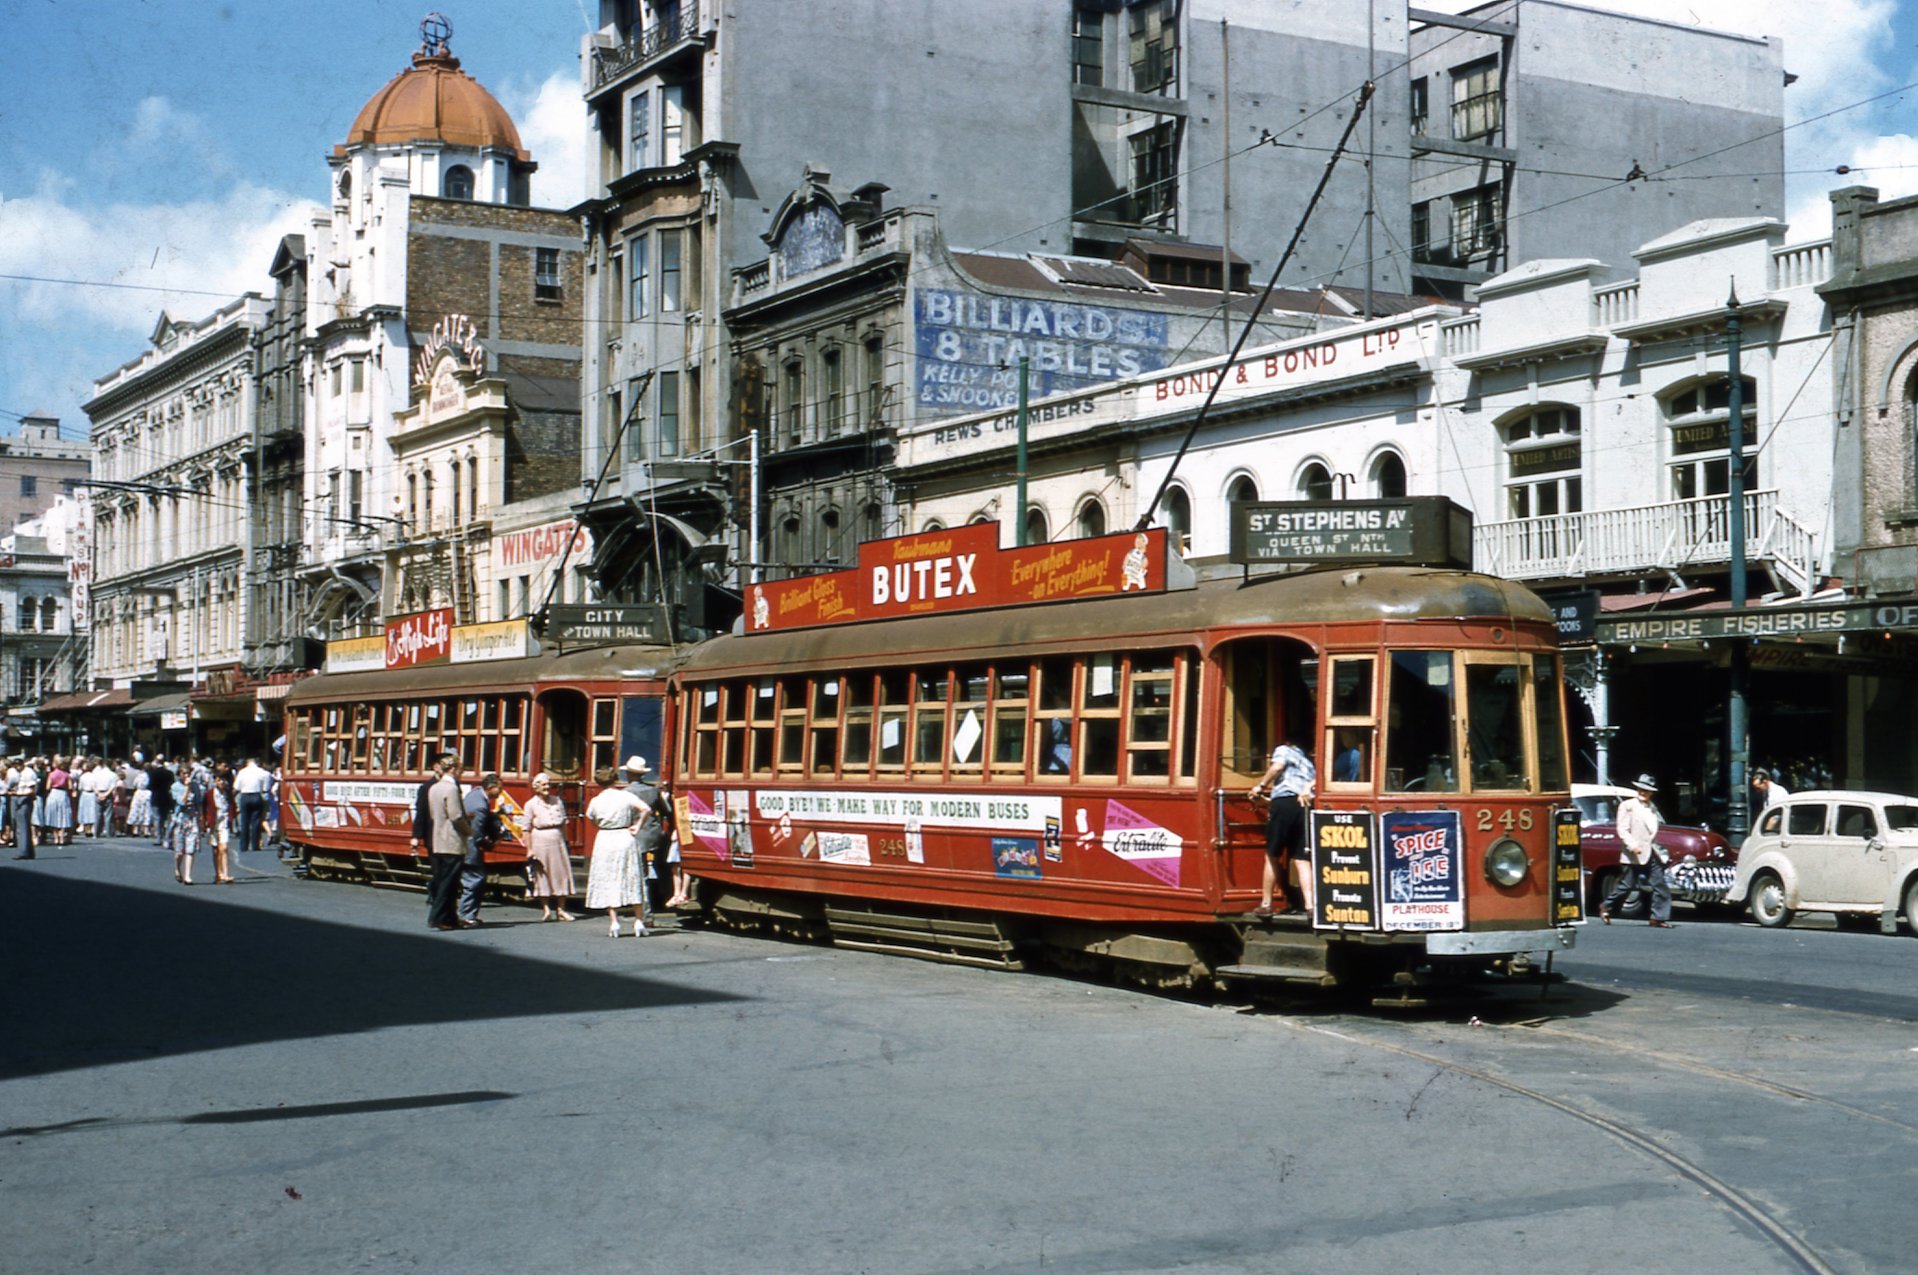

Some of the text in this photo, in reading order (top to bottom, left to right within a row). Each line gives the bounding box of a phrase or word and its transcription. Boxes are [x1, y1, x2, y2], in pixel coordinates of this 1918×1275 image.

[926, 291, 1146, 344] BILLIARDS
[936, 330, 1141, 378] 8 TABLES
[922, 364, 982, 386] KELLY
[1156, 367, 1221, 401] BOND
[1236, 363, 1248, 384] &
[1265, 342, 1337, 378] BOND
[935, 423, 982, 445] REWS
[1250, 514, 1272, 531] ST
[1278, 510, 1381, 531] STEPHENS
[1258, 543, 1392, 557] VIA TOWN HALL
[1269, 533, 1386, 548] QUEEN ST NTH
[1011, 547, 1073, 586] Everywhere
[872, 553, 977, 606] BUTEX
[585, 610, 624, 622] CITY
[817, 590, 844, 620] Finish
[574, 626, 611, 638] TOWN
[616, 626, 652, 638] HALL
[1723, 610, 1847, 634] FISHERIES
[759, 796, 784, 811] GOOD
[789, 796, 813, 813] BYE!
[872, 799, 897, 815] WAY
[903, 800, 924, 816] FOR
[930, 801, 981, 819] MODERN
[988, 803, 1030, 820] BUSES
[1333, 815, 1353, 824] USE
[1476, 808, 1533, 831] 248
[1320, 825, 1368, 849] SKOL
[1322, 865, 1370, 885] Sunburn
[1325, 904, 1370, 923] Suntan
